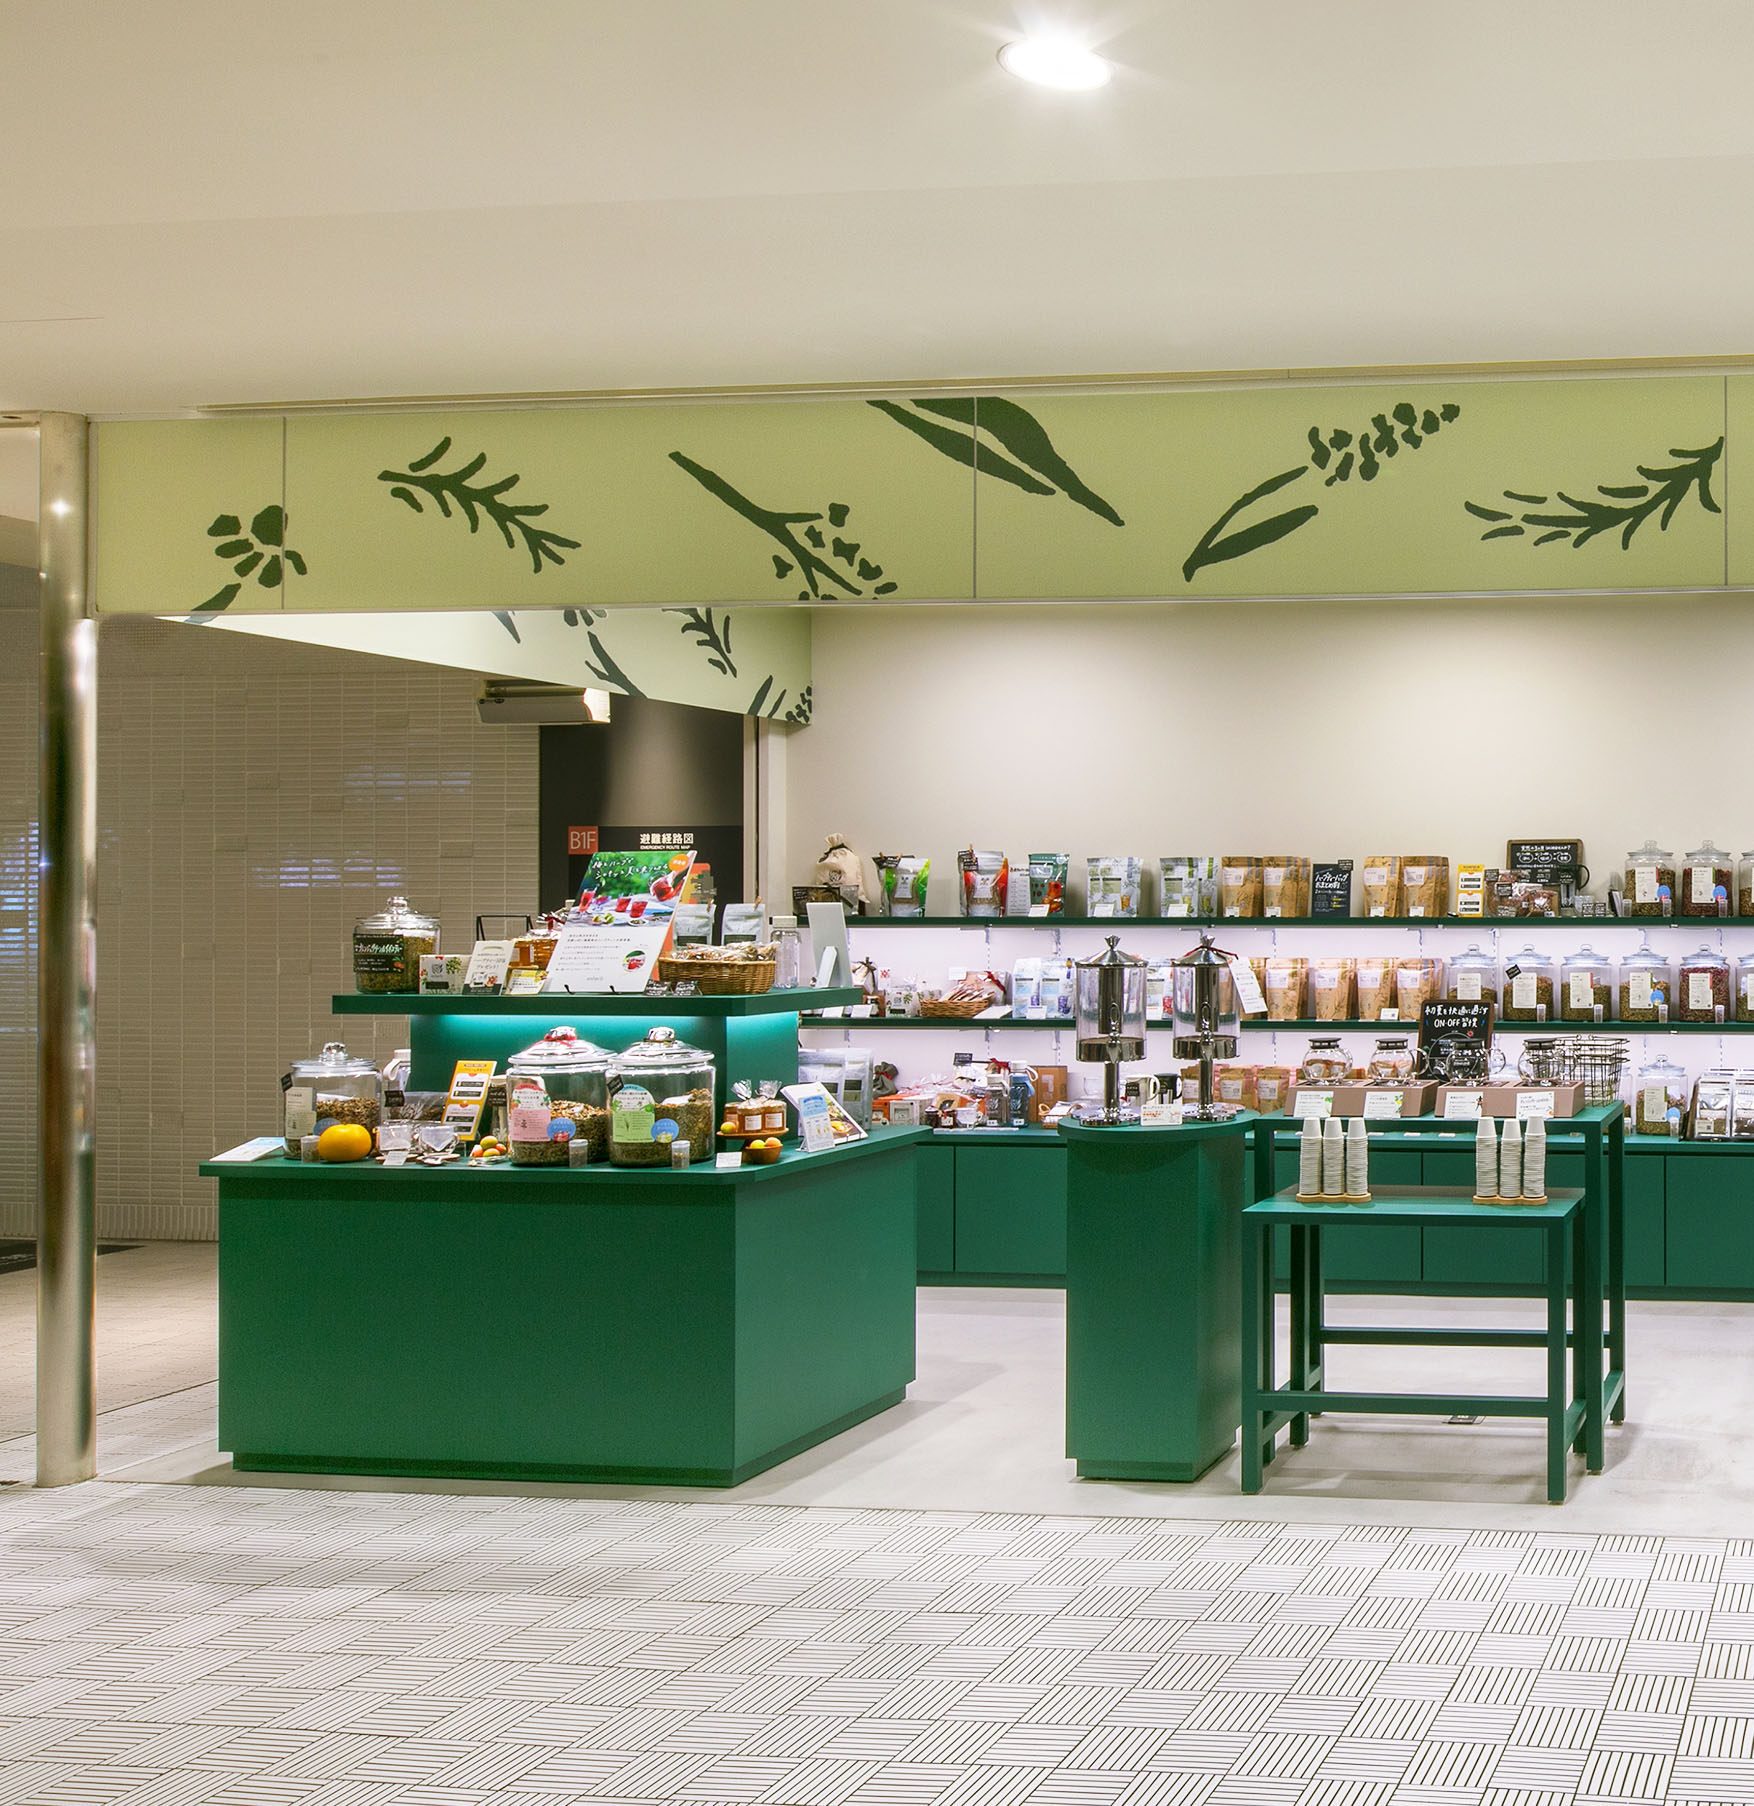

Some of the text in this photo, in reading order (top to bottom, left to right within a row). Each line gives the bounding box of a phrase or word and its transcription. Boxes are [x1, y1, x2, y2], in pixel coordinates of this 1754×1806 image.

[570, 831, 597, 850] B1F
[640, 833, 694, 844] 避難経路図
